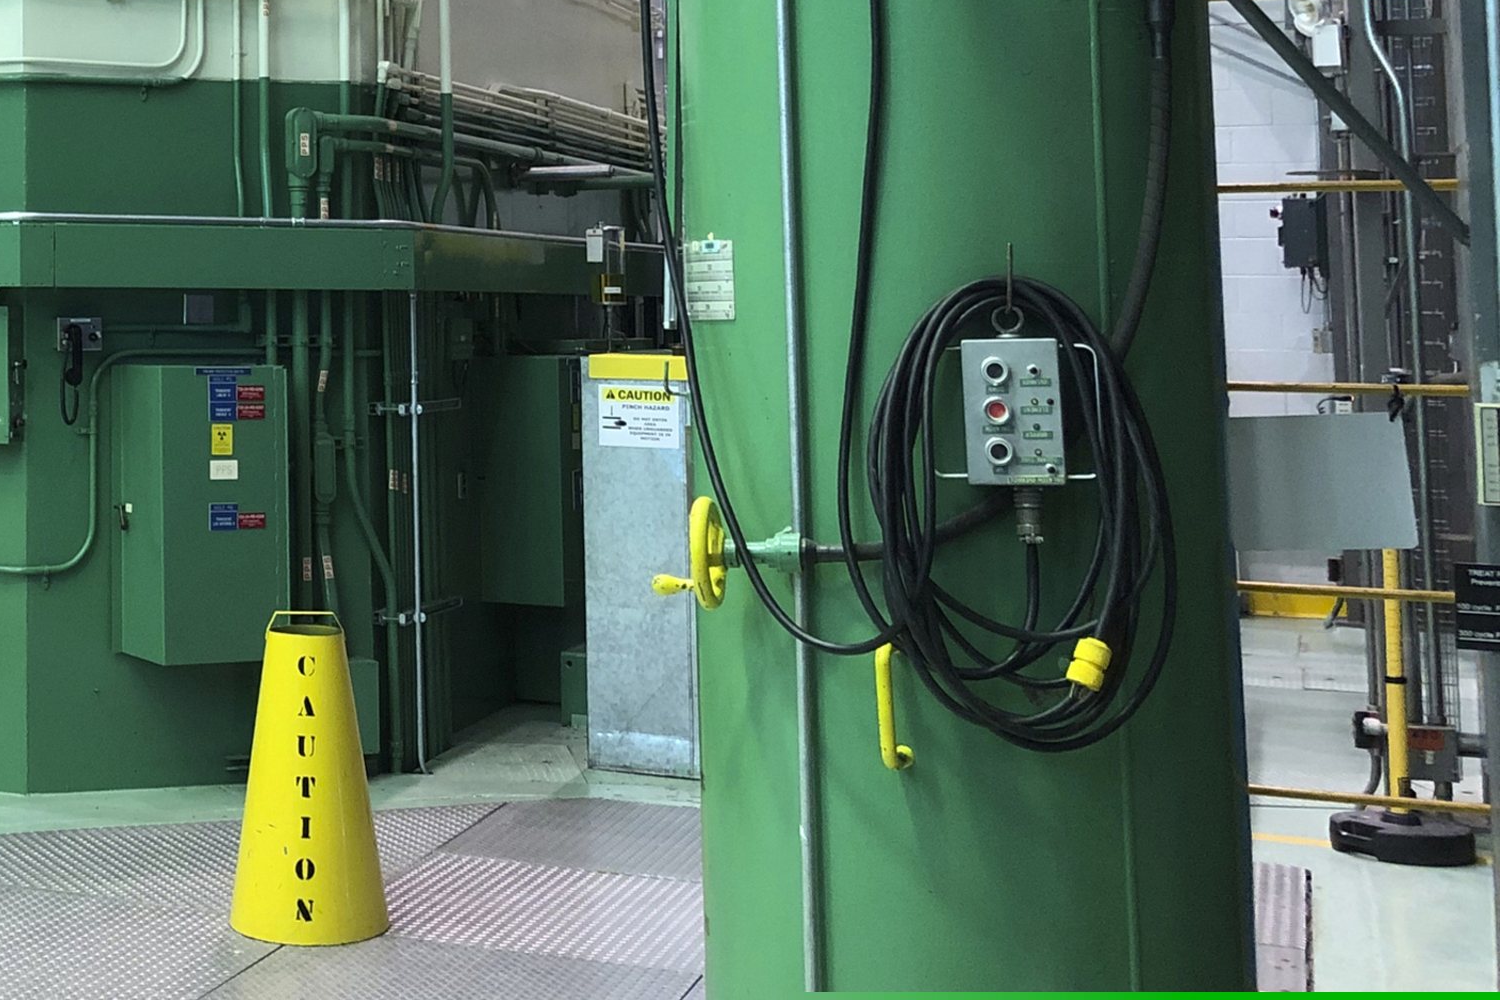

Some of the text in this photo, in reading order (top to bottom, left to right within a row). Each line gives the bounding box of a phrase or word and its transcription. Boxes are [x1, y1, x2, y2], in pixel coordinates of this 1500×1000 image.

[301, 134, 309, 155] PPS
[617, 389, 671, 402] CAUTION
[216, 465, 233, 475] PPS
[323, 557, 333, 578] PPS
[1468, 568, 1494, 577] TREAT
[295, 655, 316, 922] CAUTION
